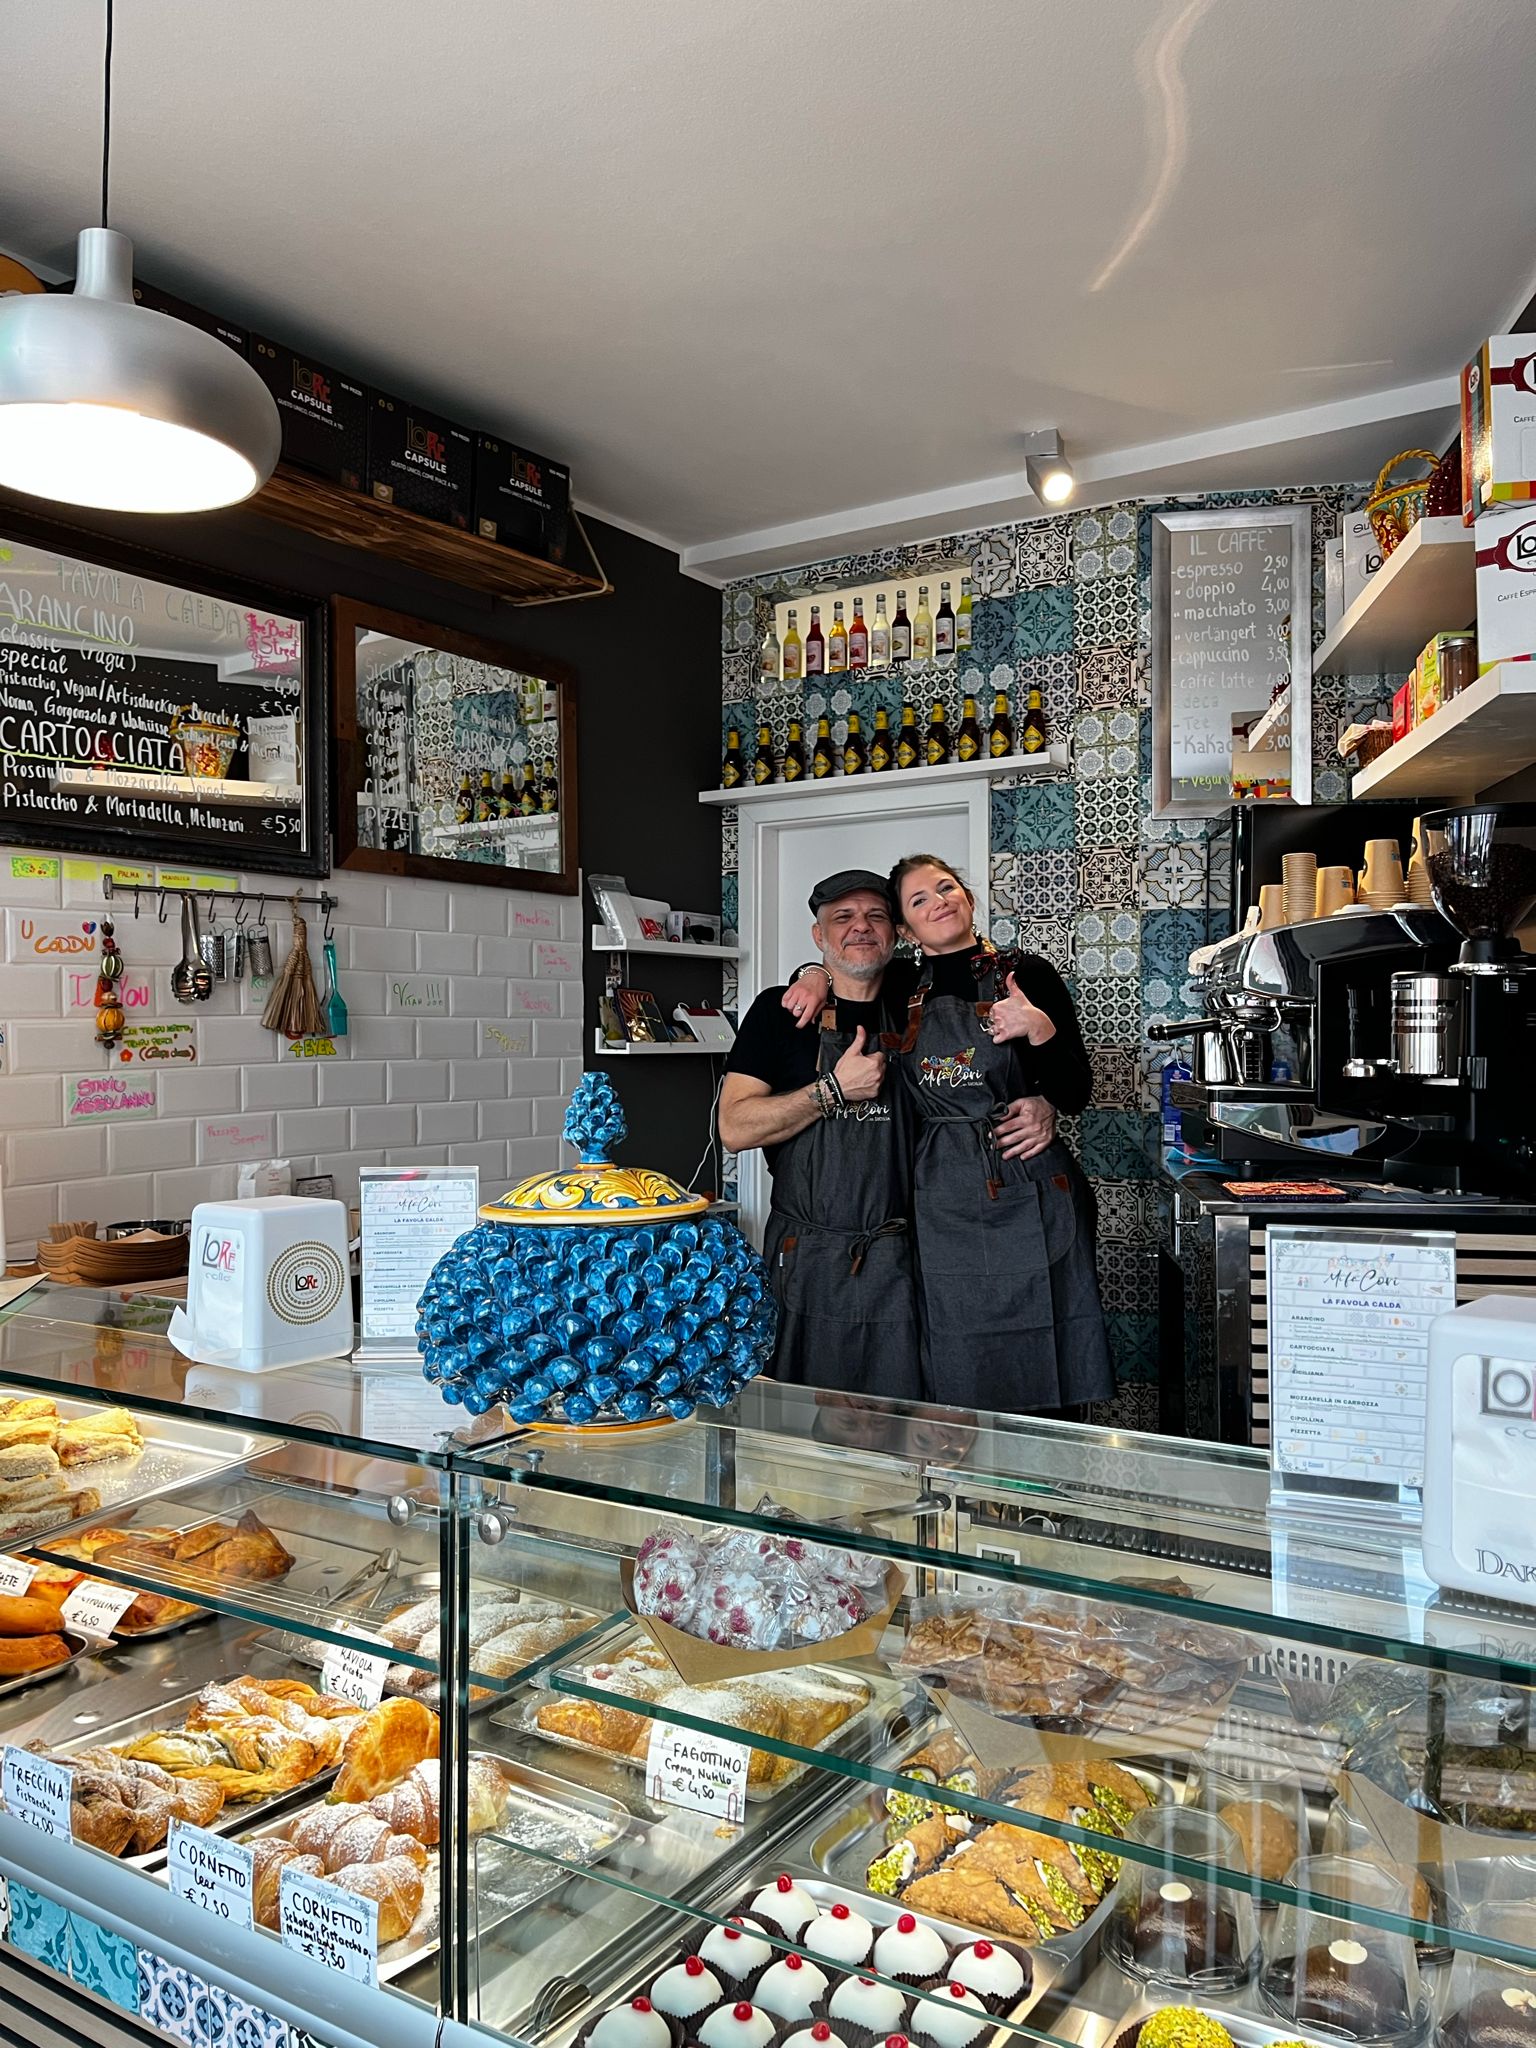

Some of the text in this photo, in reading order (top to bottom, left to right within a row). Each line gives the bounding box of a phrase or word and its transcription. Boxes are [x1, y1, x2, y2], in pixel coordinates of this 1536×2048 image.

[290, 389, 333, 415] CAPSULE
[404, 450, 447, 475] CAPSULE
[509, 478, 543, 497] CAPSULE
[1190, 534, 1208, 556] IL
[1262, 555, 1289, 575] 2,50
[1186, 575, 1290, 603] doppio 4,00
[0, 582, 135, 647] ARANCINO
[165, 591, 243, 640] CALDA
[1184, 598, 1290, 621] macchiato 3,00
[1266, 623, 1290, 640] 3,00
[0, 648, 69, 675] special
[1221, 671, 1255, 689] latte
[231, 713, 242, 729] &
[1183, 715, 1210, 731] Tee
[0, 716, 186, 770] CARTOCCIATA
[1265, 734, 1291, 752] 3,00
[3, 752, 73, 781] Prosciutto
[85, 766, 95, 782] &
[3, 781, 78, 812] Pistacchio
[84, 795, 99, 814] &
[21, 919, 34, 940] U
[1322, 1297, 1402, 1309] LA FAVOLA CALDA
[1291, 1314, 1326, 1323] ARANCINO
[1289, 1344, 1335, 1352] CARTOCCIATA
[1289, 1394, 1333, 1403] MOZZARELLA
[1342, 1399, 1380, 1408] CARROZZA
[1289, 1415, 1325, 1424] CIPOLLINA
[1290, 1428, 1322, 1436] PIZZETTA
[673, 1742, 742, 1774] FAGOTTINO
[8, 1762, 64, 1802] TRECCINA
[15, 1783, 56, 1816] Pistacchio
[179, 1840, 247, 1889] CORNETTO
[292, 1891, 363, 1935] CORNETTO
